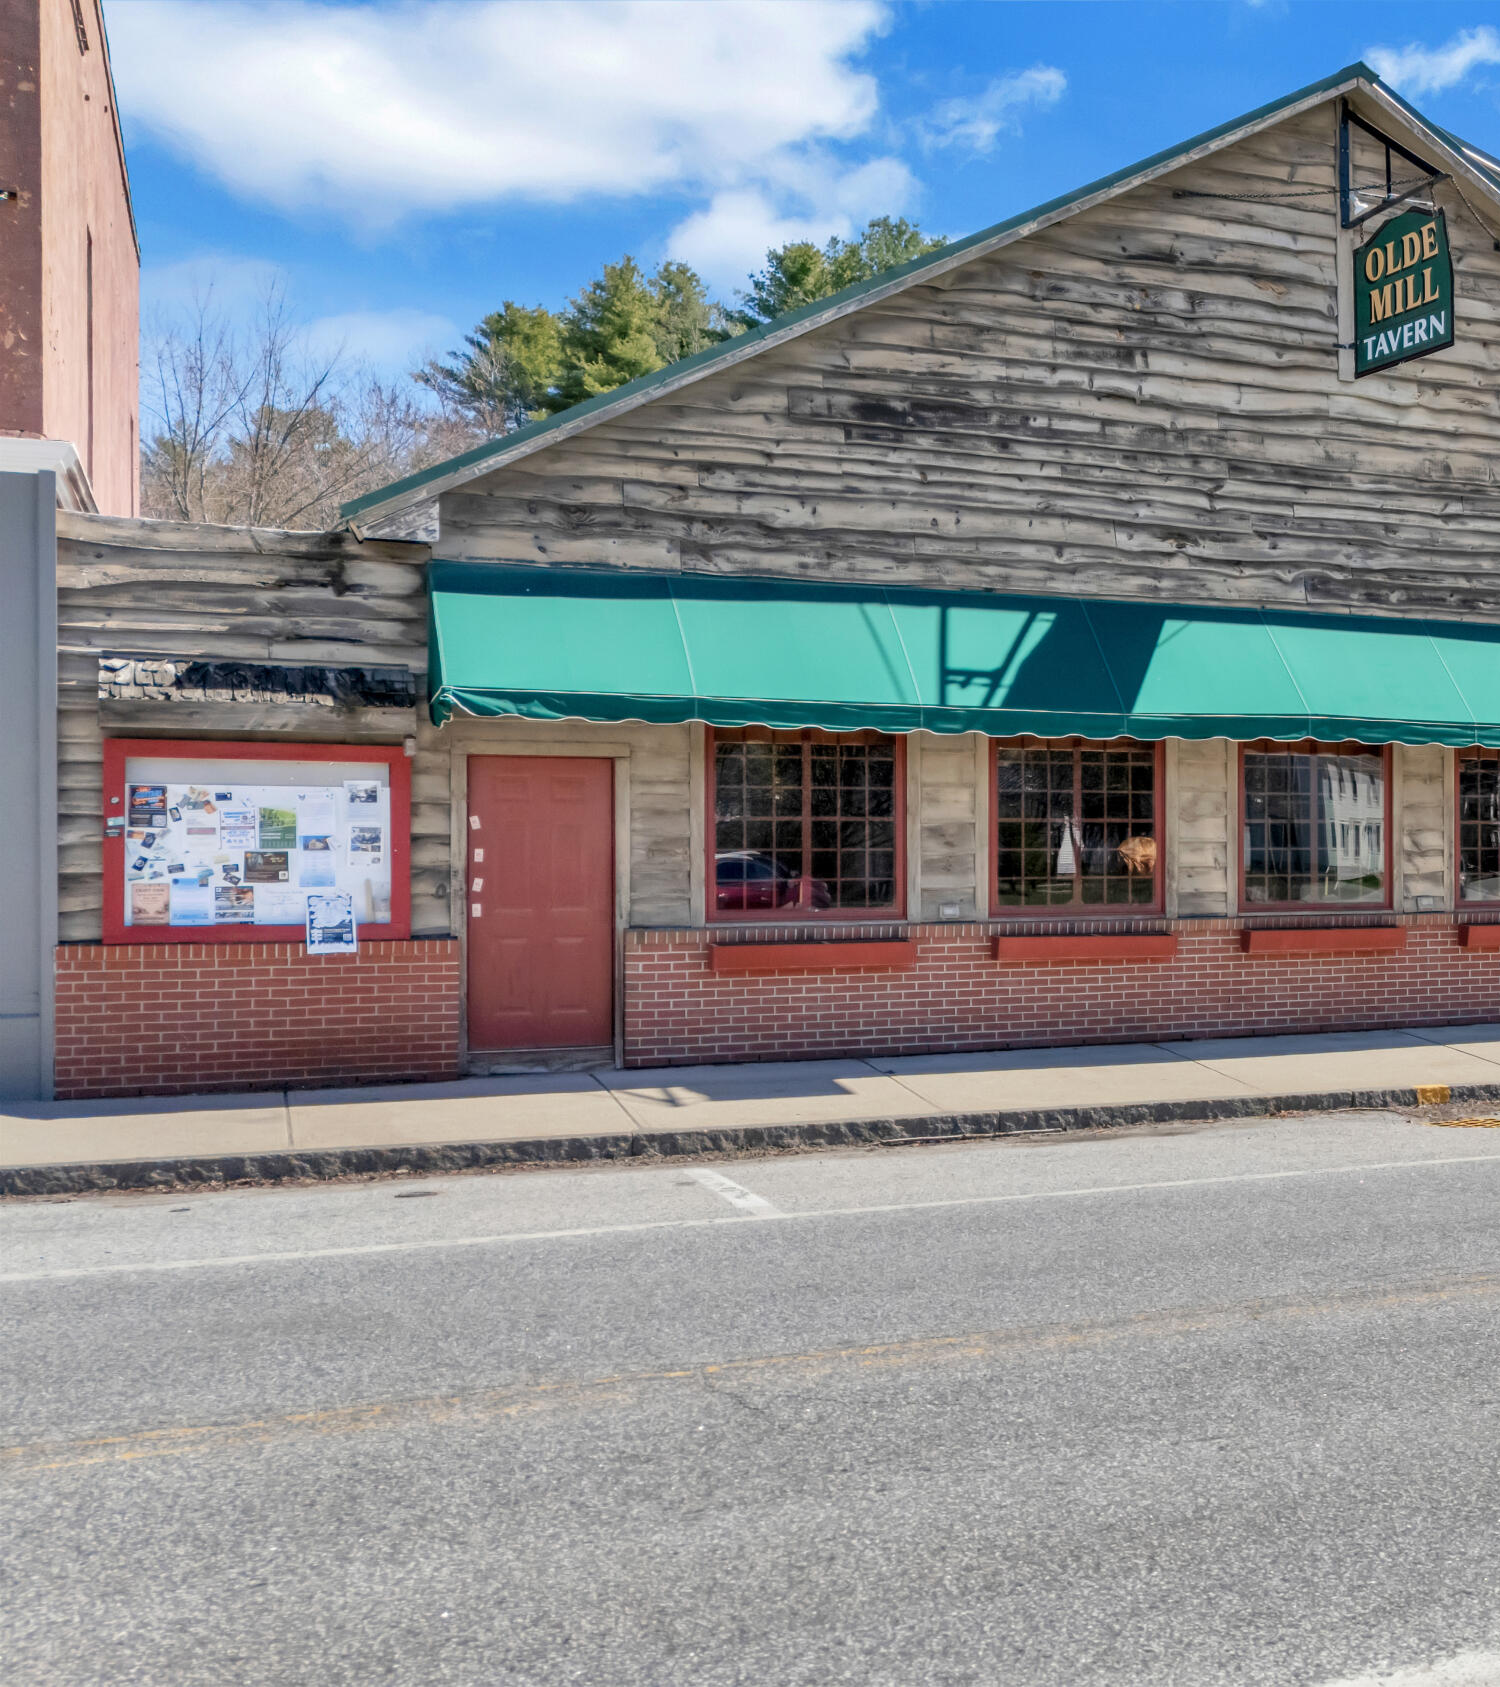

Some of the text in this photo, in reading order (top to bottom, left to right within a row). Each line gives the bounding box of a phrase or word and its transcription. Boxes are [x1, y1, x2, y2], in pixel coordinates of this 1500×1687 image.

[1366, 222, 1438, 282] OLDE
[1370, 267, 1439, 324] MILL
[1364, 311, 1445, 360] TAVERN
